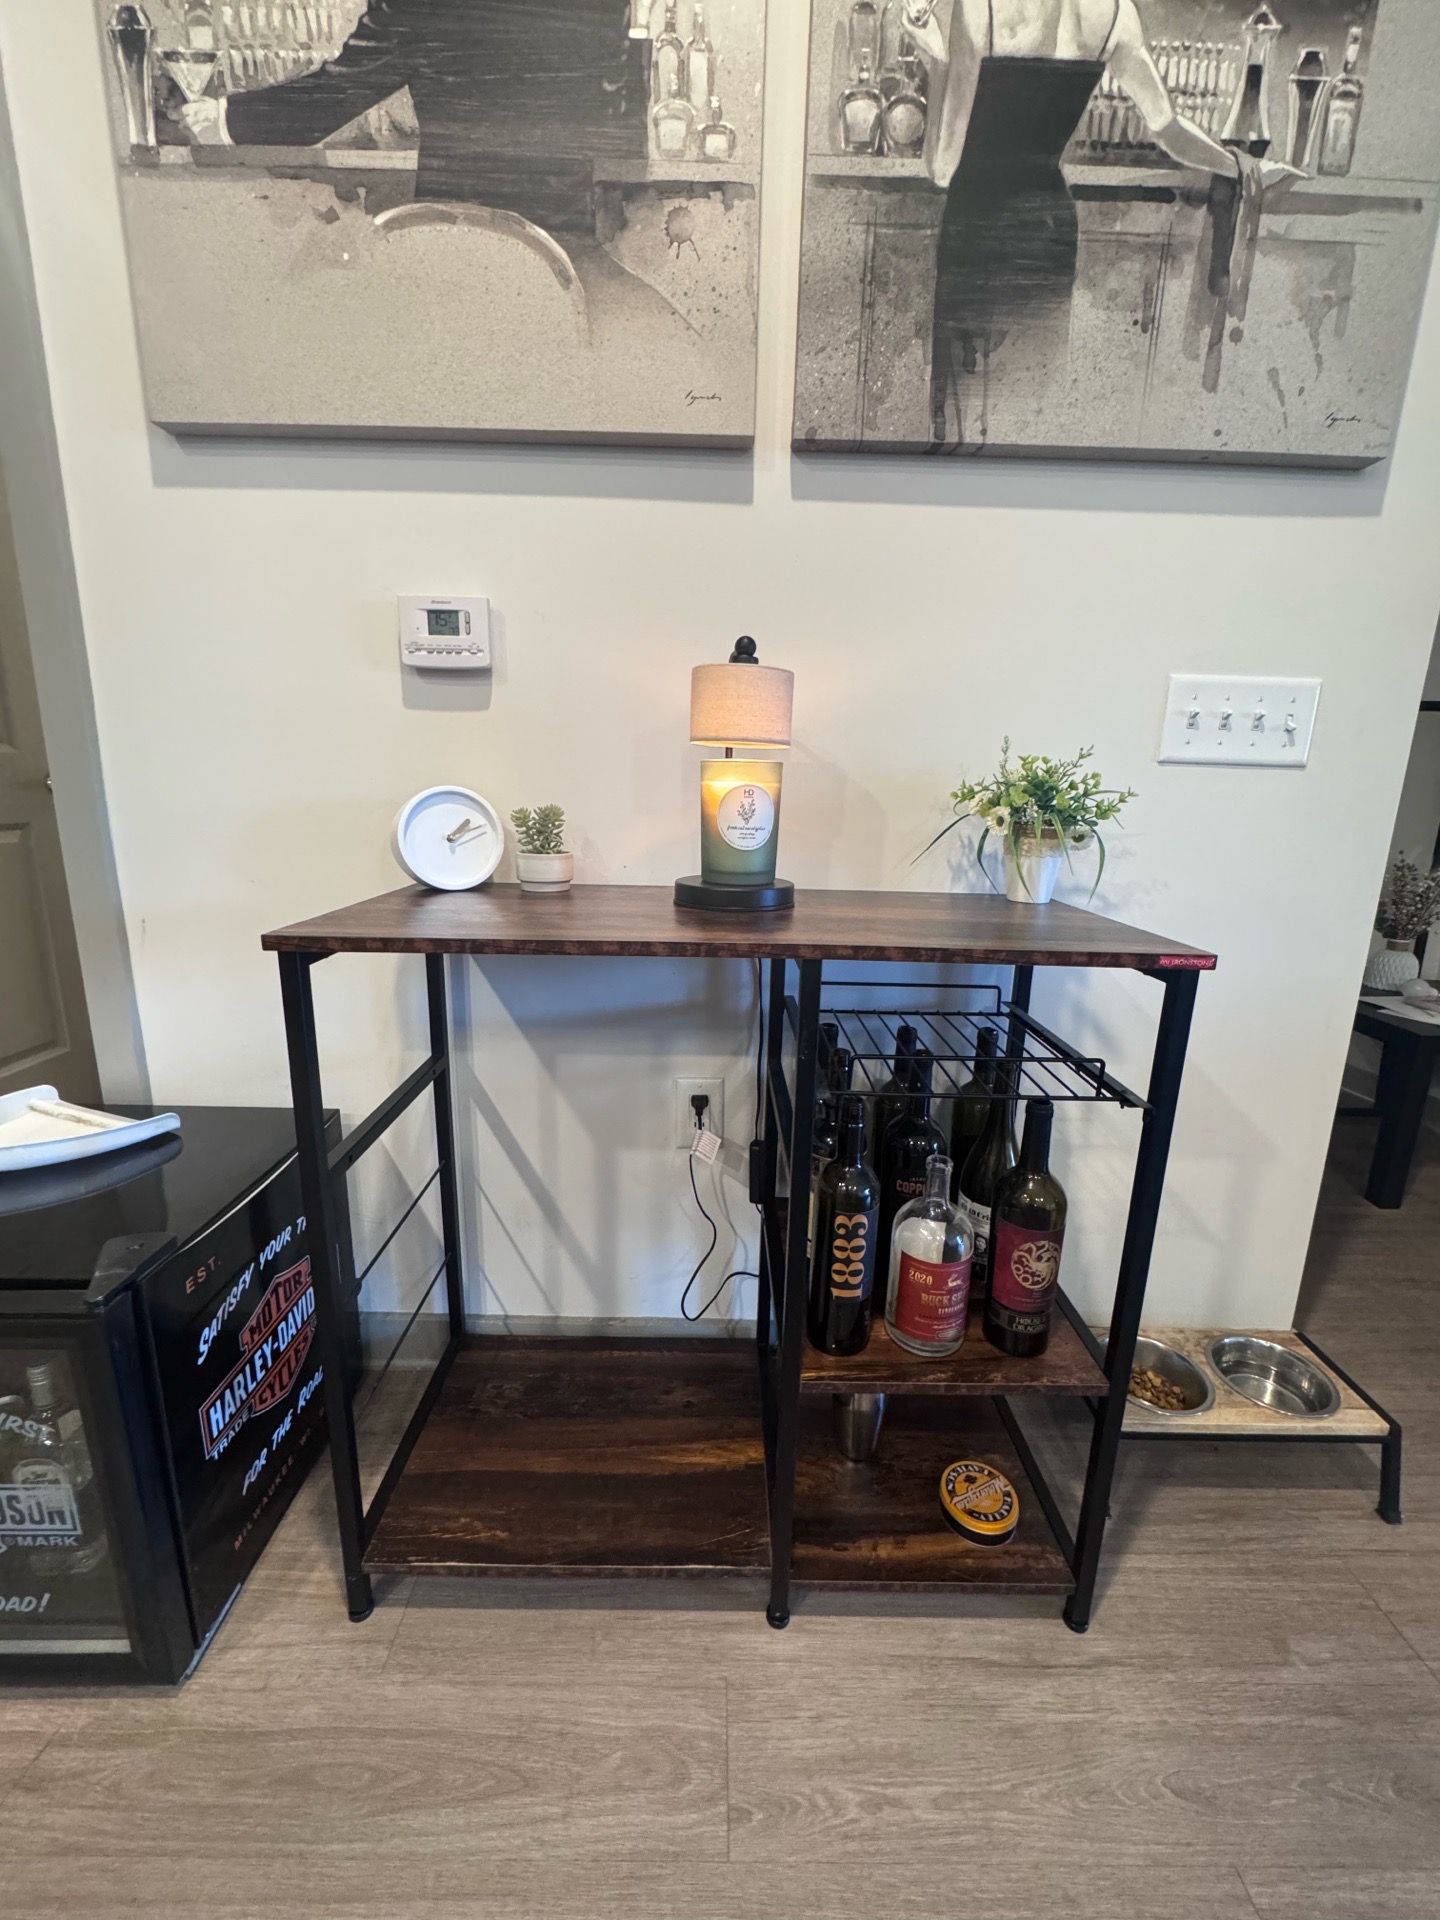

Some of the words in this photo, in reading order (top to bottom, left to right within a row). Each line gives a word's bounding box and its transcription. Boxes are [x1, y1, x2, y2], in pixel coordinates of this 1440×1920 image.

[185, 1256, 222, 1294] EST.
[831, 1214, 868, 1301] 1883
[908, 1268, 933, 1286] 2020
[197, 1262, 255, 1366] SATISFY
[260, 1225, 292, 1270] YOUR
[249, 1269, 303, 1344] MOTOR
[212, 1408, 251, 1461] TRADE
[242, 1447, 268, 1496] FOR
[271, 1408, 293, 1451] THE
